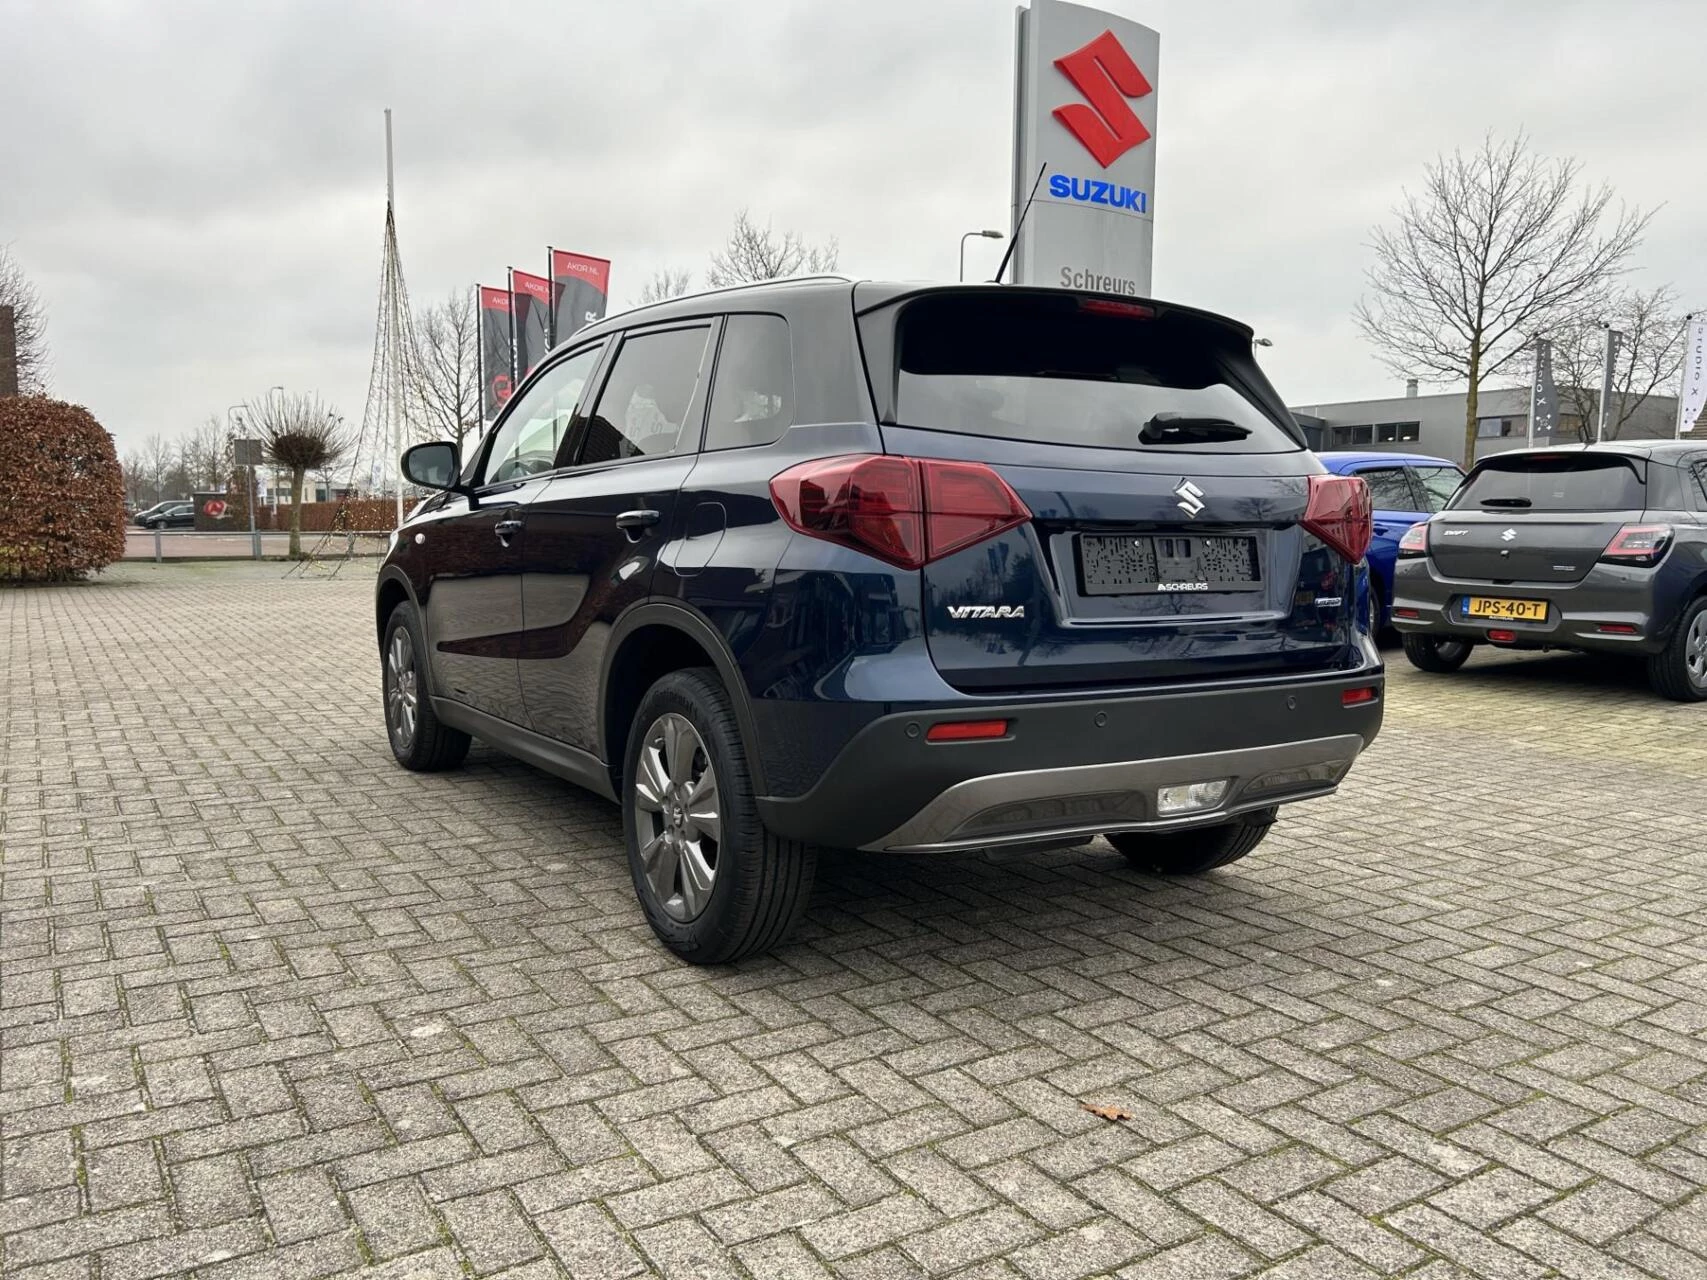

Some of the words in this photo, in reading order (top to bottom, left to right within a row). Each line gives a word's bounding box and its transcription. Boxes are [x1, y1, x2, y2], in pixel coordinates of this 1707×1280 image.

[1050, 175, 1147, 214] SUZUKI
[1060, 266, 1136, 296] Schreurs
[947, 605, 1025, 620] VITARA
[1475, 600, 1540, 616] JPS-40-T
